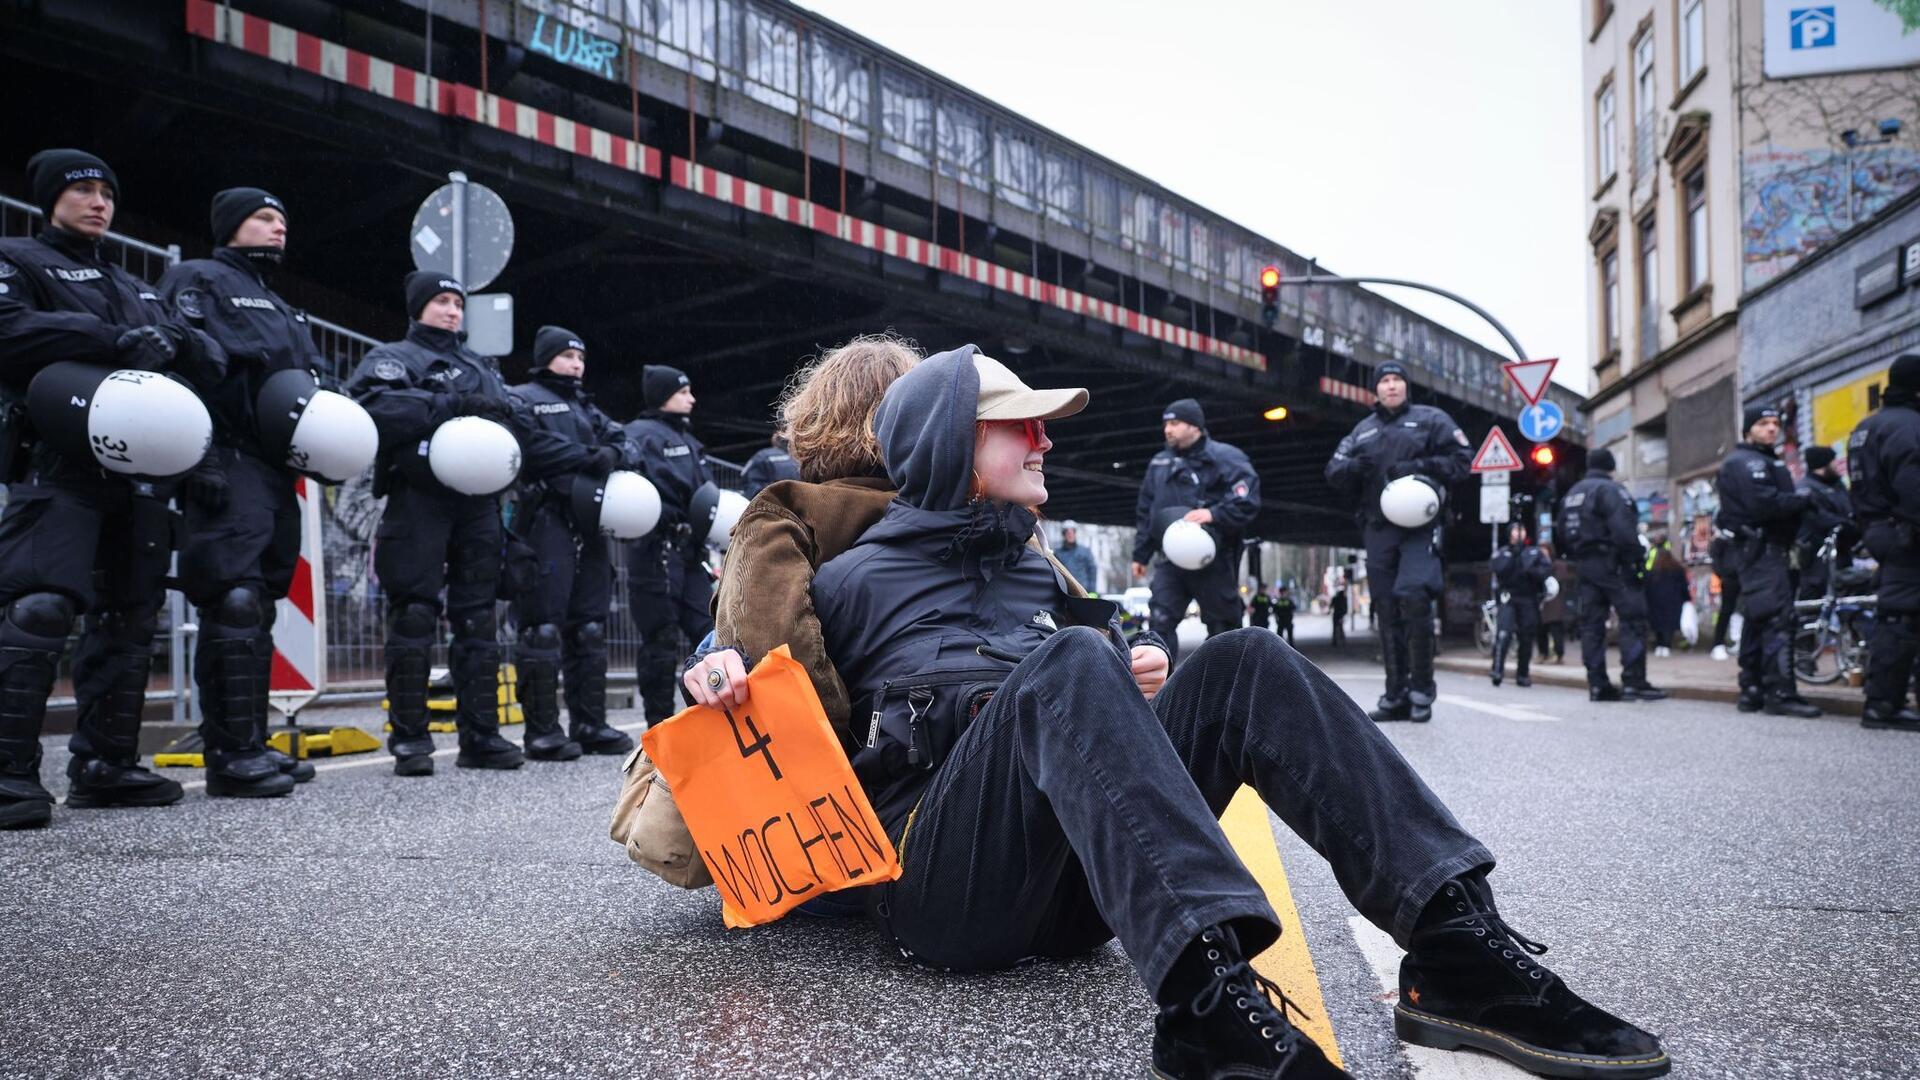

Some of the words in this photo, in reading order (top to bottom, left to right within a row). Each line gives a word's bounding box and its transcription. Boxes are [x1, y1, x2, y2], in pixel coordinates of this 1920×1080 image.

[1801, 20, 1830, 47] P
[71, 395, 87, 408] 2
[102, 435, 134, 464] 31
[724, 710, 783, 781] 4
[705, 784, 886, 910] WOCHEN
